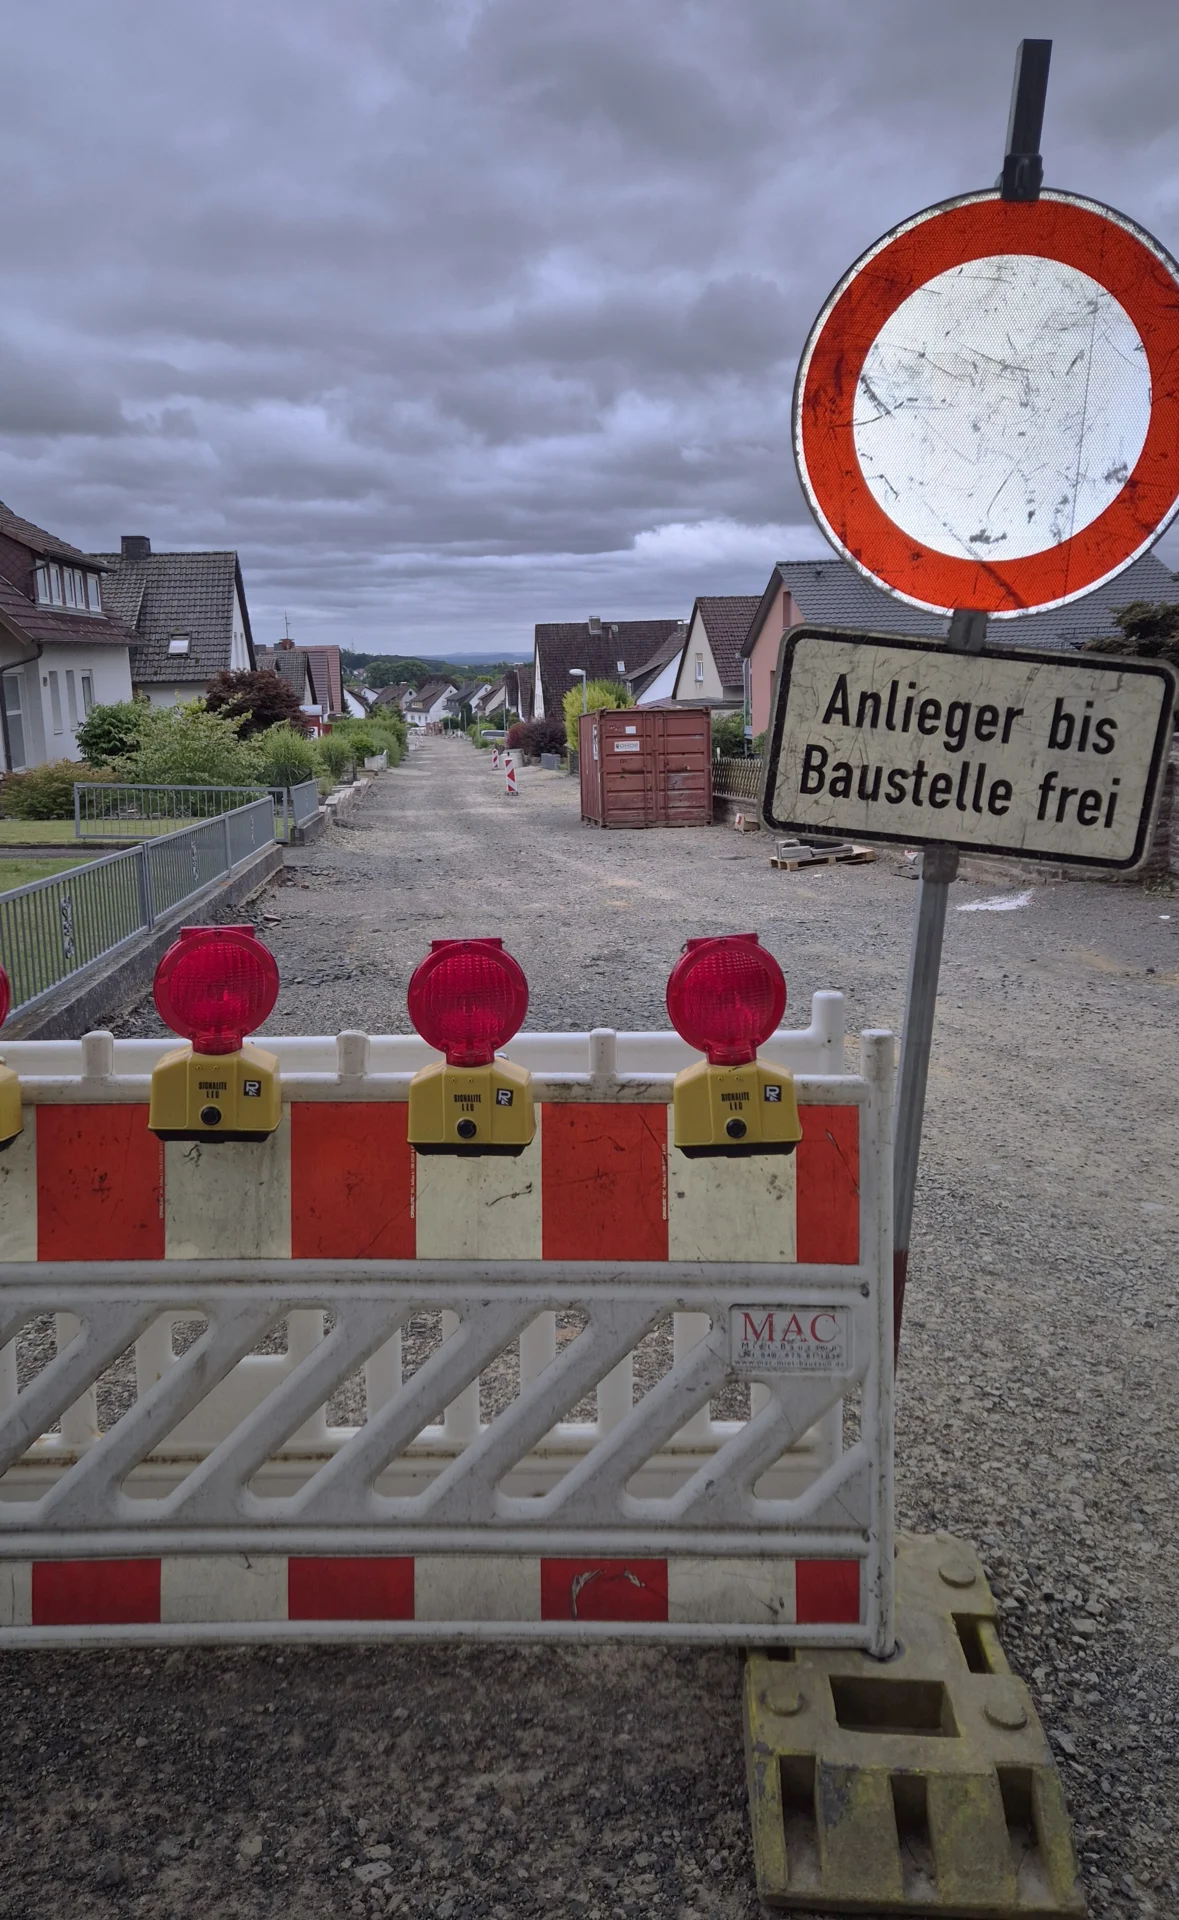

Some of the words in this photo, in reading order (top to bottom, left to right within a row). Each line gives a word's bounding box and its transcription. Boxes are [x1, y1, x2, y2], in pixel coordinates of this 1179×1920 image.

[822, 673, 1025, 753] Anlieger
[1047, 697, 1118, 755] bis
[799, 743, 1014, 816] Baustelle
[1036, 770, 1122, 829] frei
[740, 1311, 839, 1343] MAC
